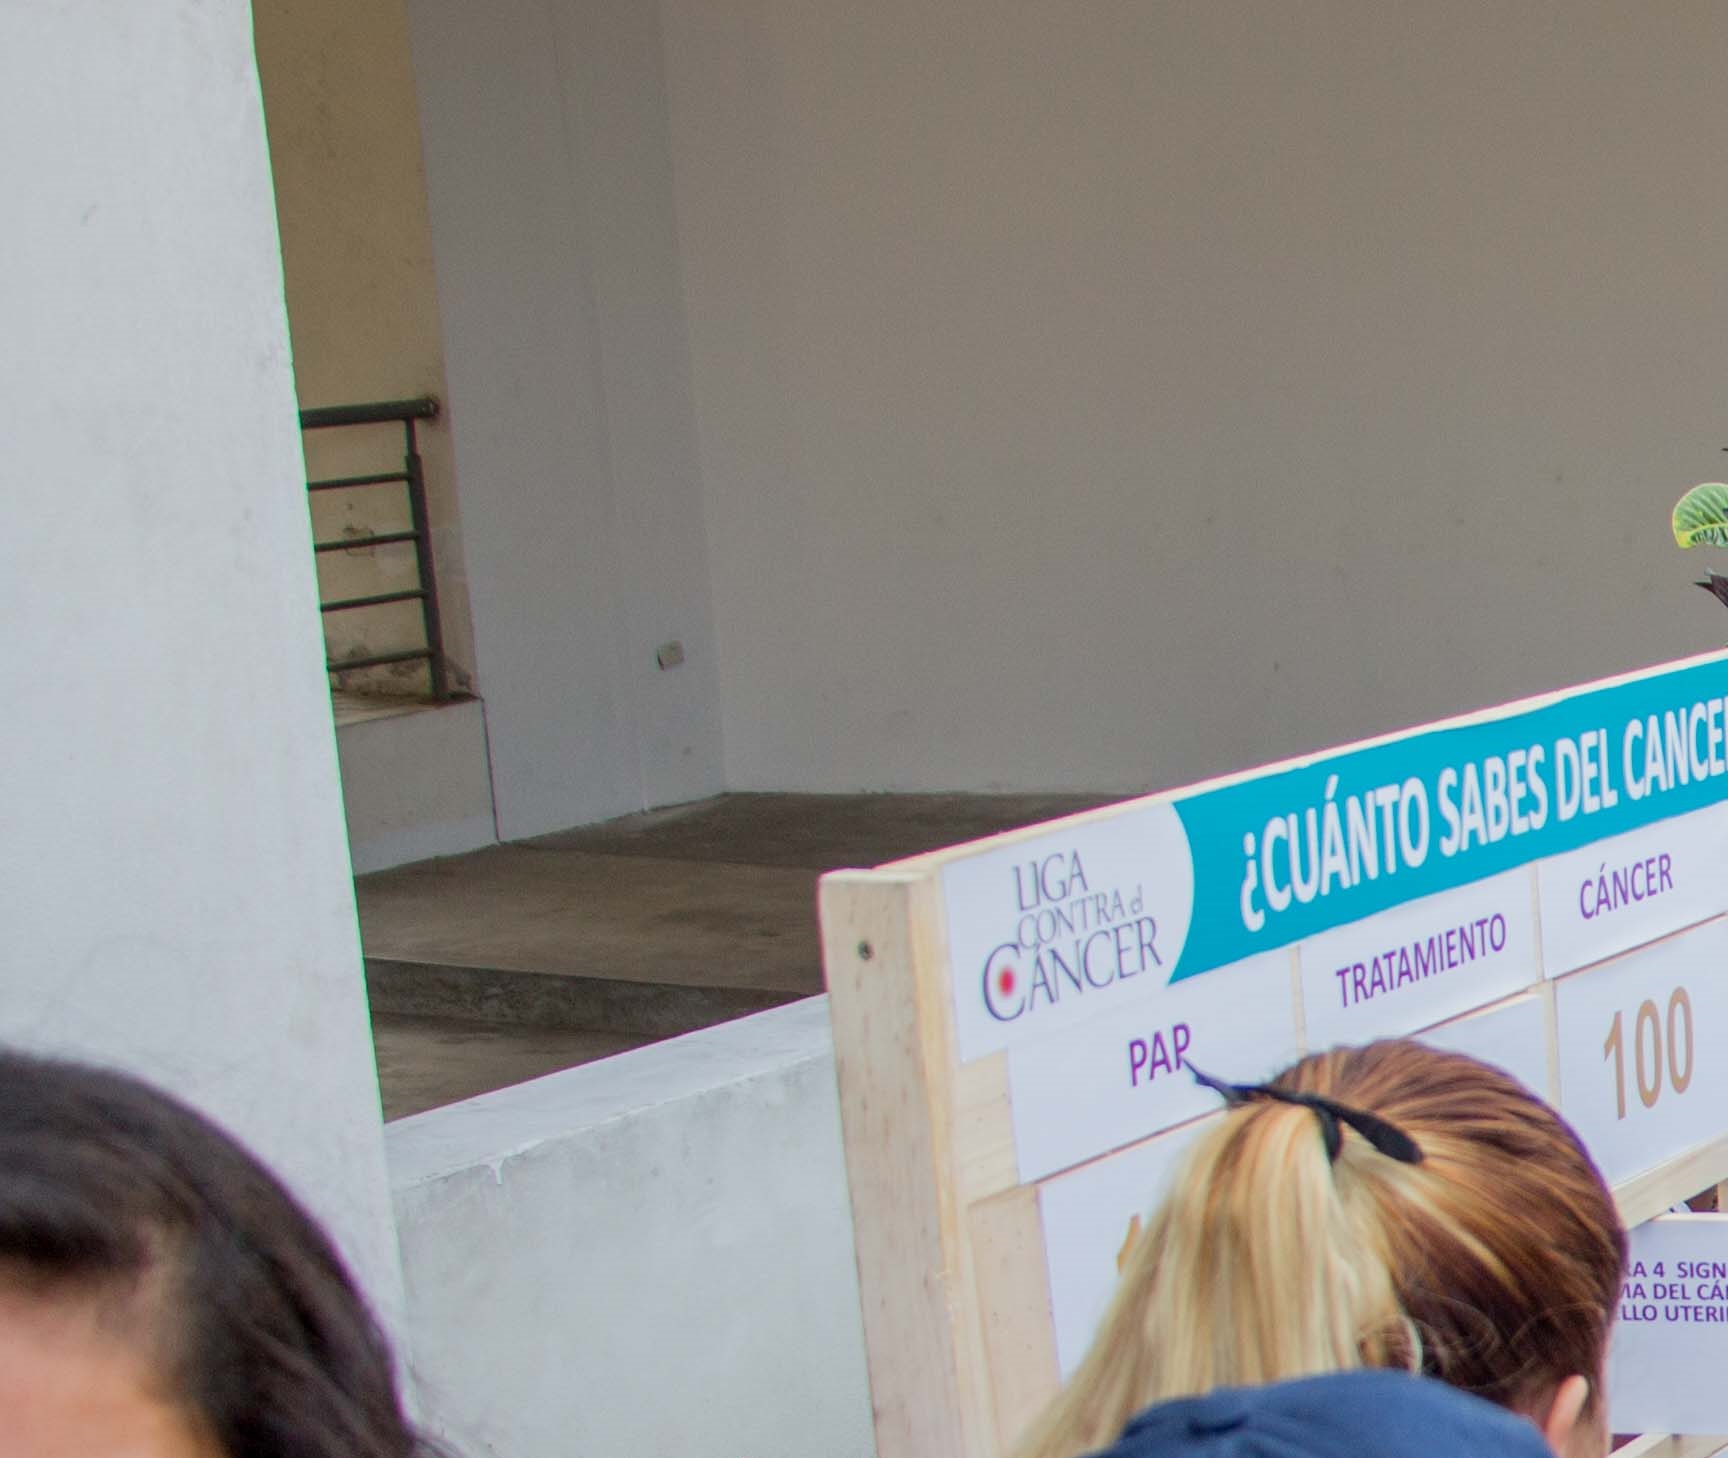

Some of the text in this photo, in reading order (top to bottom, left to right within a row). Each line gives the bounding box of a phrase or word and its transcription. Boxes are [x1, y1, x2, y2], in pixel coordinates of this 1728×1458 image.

[1239, 774, 1431, 933] ¿CUÁNTO
[1437, 743, 1548, 858] SABES
[1554, 728, 1618, 822] DEL
[1013, 849, 1089, 912] LIGA
[1578, 852, 1674, 921] CÁNCER
[1016, 890, 1127, 952] CONTRA
[1335, 912, 1507, 1008] TRATAMIENTO
[1128, 1022, 1191, 1087] PAP
[1603, 986, 1694, 1121] 100
[1652, 1261, 1666, 1279] 4
[1652, 1283, 1692, 1301] DEL
